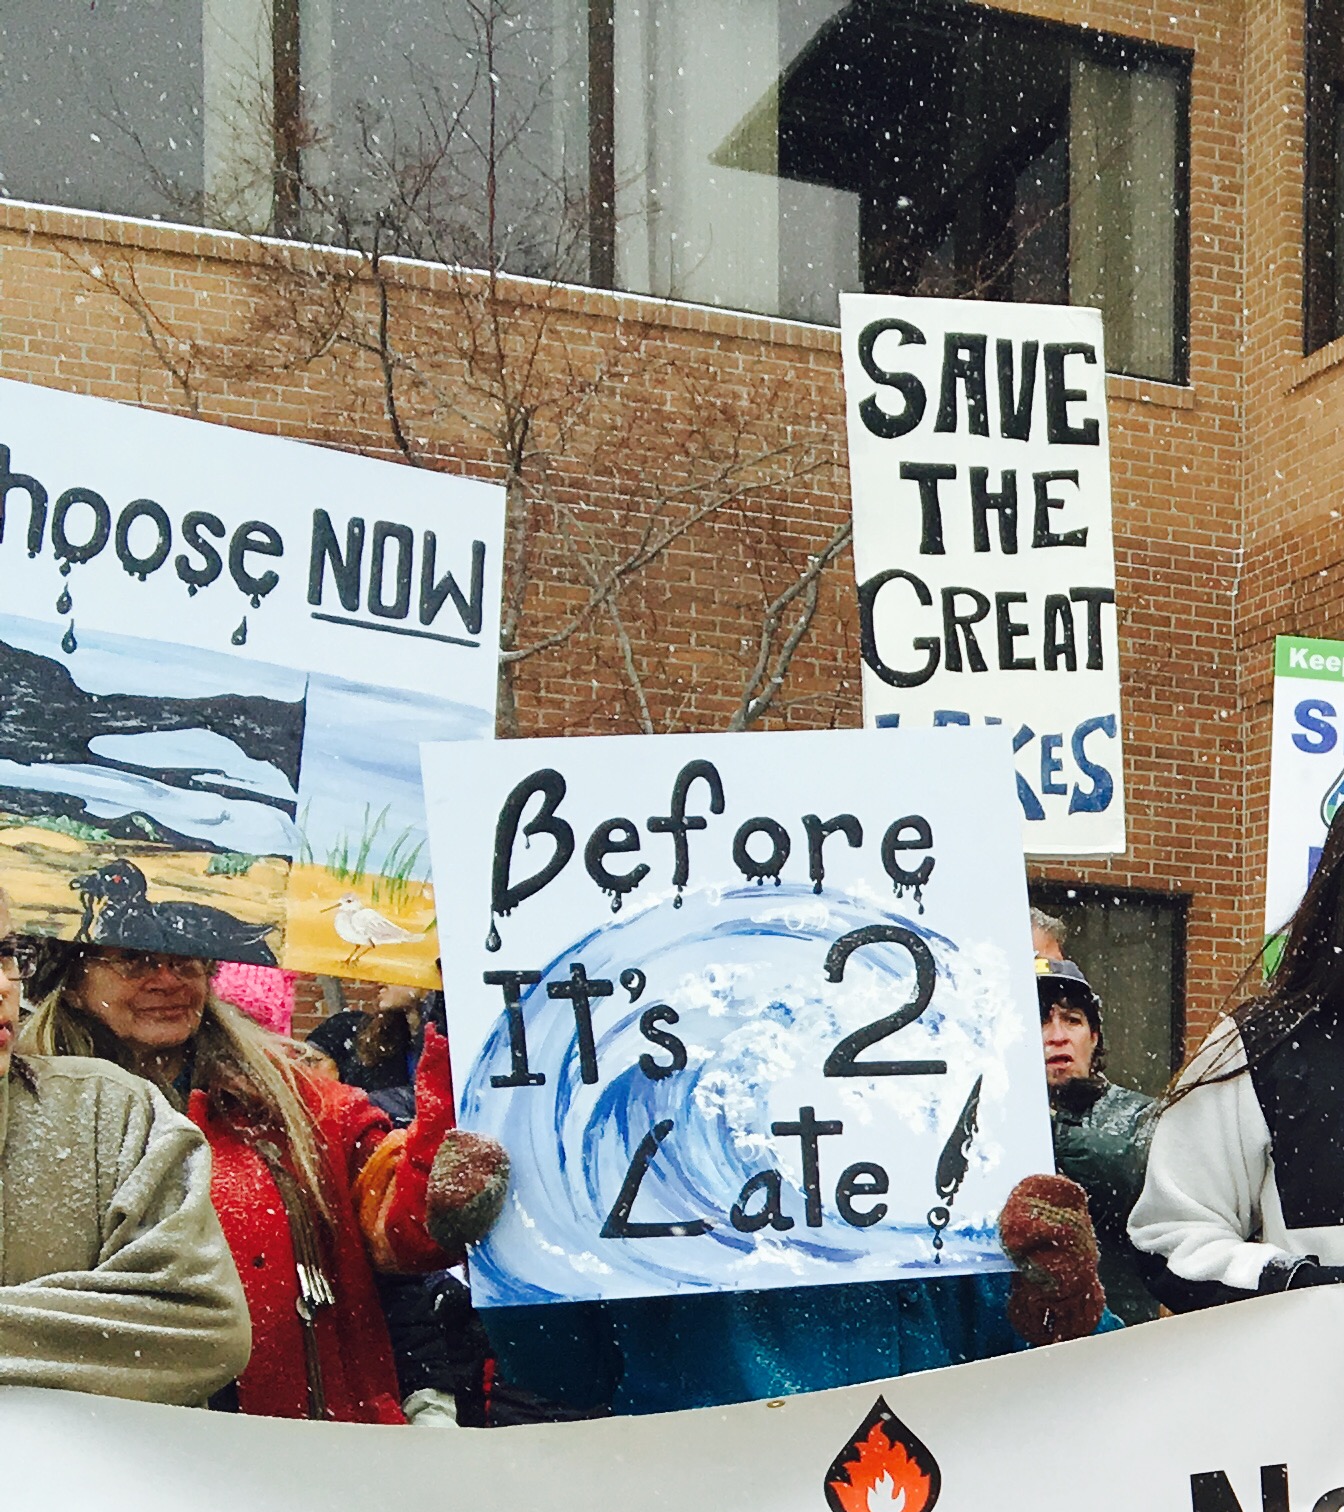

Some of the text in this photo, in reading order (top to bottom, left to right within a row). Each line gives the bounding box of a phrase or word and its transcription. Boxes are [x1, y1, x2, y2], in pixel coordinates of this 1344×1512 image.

[858, 318, 1100, 446] SAVE
[0, 444, 486, 634] hoose NOW
[900, 461, 1088, 554] THE
[859, 569, 1114, 687] GREAT
[490, 758, 936, 915] Before
[483, 925, 947, 1087] It's 2
[600, 1074, 982, 1264] Late!
